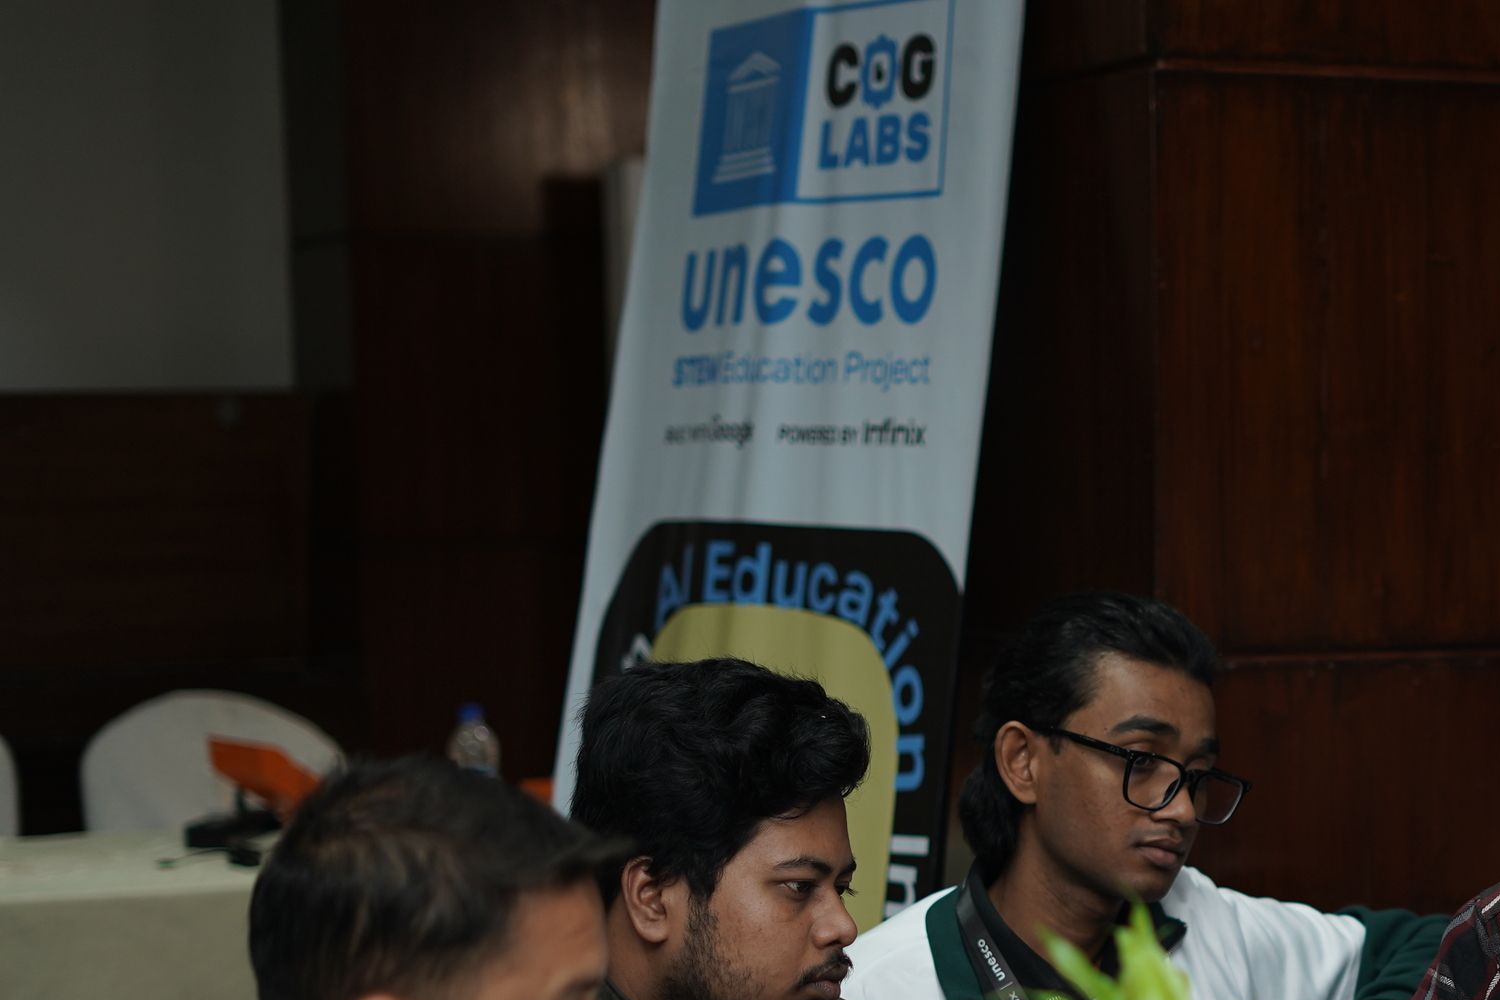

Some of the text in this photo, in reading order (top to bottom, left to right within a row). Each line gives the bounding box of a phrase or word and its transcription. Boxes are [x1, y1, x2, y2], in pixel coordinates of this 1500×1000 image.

[825, 33, 938, 109] COG
[817, 112, 931, 170] LABS
[680, 233, 938, 333] unesco
[719, 351, 838, 385] Education
[845, 351, 931, 392] Project
[654, 542, 694, 634] AI
[703, 540, 926, 792] Education
[977, 939, 1006, 982] unesco
